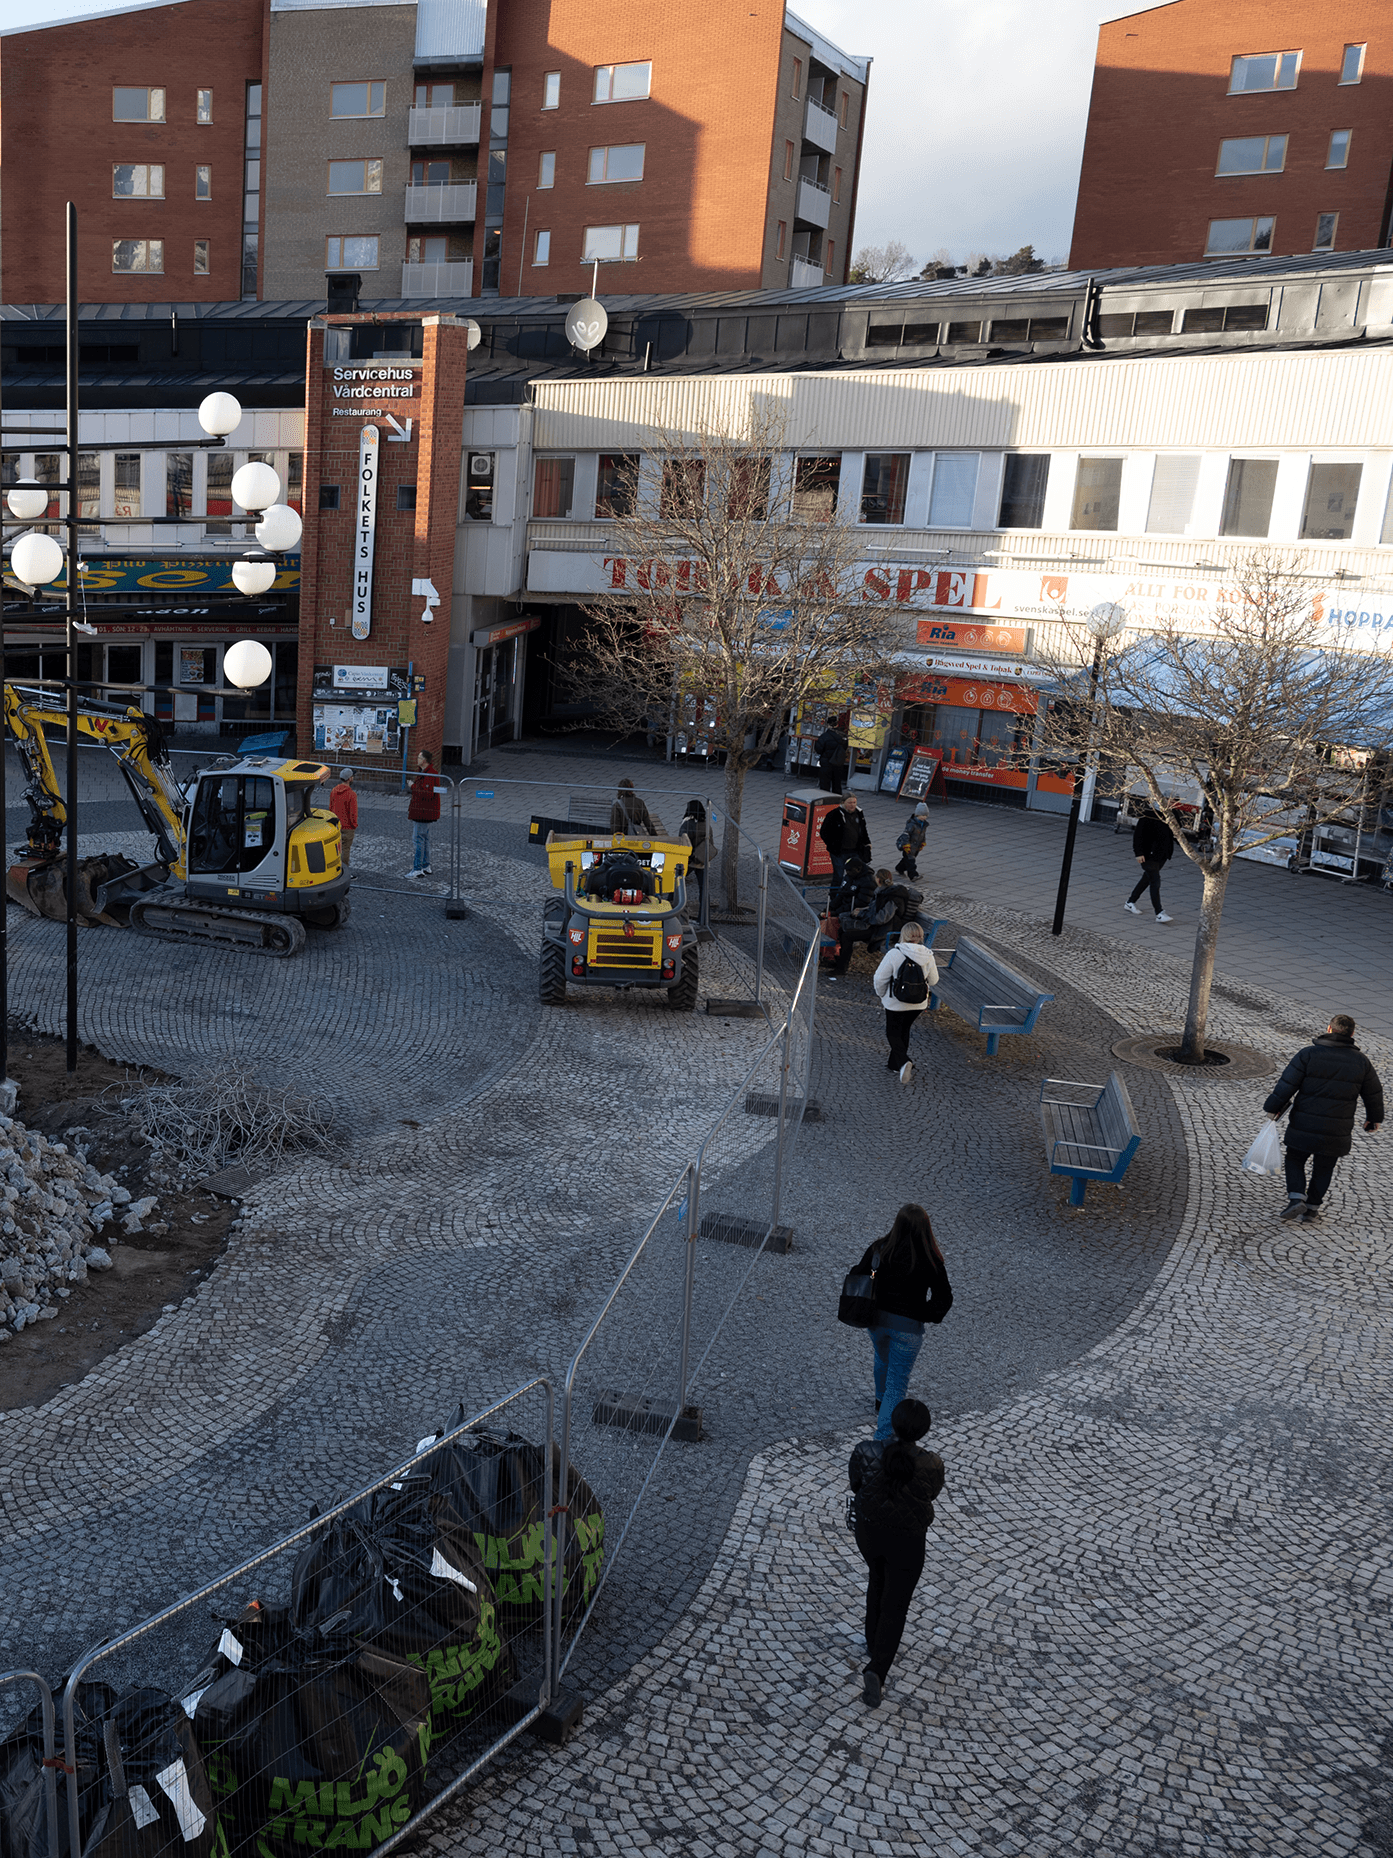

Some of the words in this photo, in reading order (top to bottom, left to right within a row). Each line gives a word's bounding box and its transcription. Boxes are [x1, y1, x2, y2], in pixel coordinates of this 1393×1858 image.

[333, 367, 414, 381] Servicehus
[333, 384, 414, 398] Vårdcentral
[333, 407, 382, 417] Restaurang
[360, 453, 373, 558] FOLKETS
[357, 571, 369, 613] HUS
[862, 567, 1002, 610] SPEL
[1126, 582, 1167, 598] ALLT
[1172, 582, 1209, 602] FÖR
[1014, 604, 1091, 618] svenskaspel.se
[1328, 608, 1393, 630] HOPPA
[153, 625, 193, 633] AVHÄMTNING
[929, 624, 956, 640] Ria
[965, 661, 982, 671] Spel
[990, 664, 1013, 674] Tobak
[950, 767, 970, 776] money
[970, 770, 995, 779] transfer
[268, 1745, 408, 1817] MILJÖ
